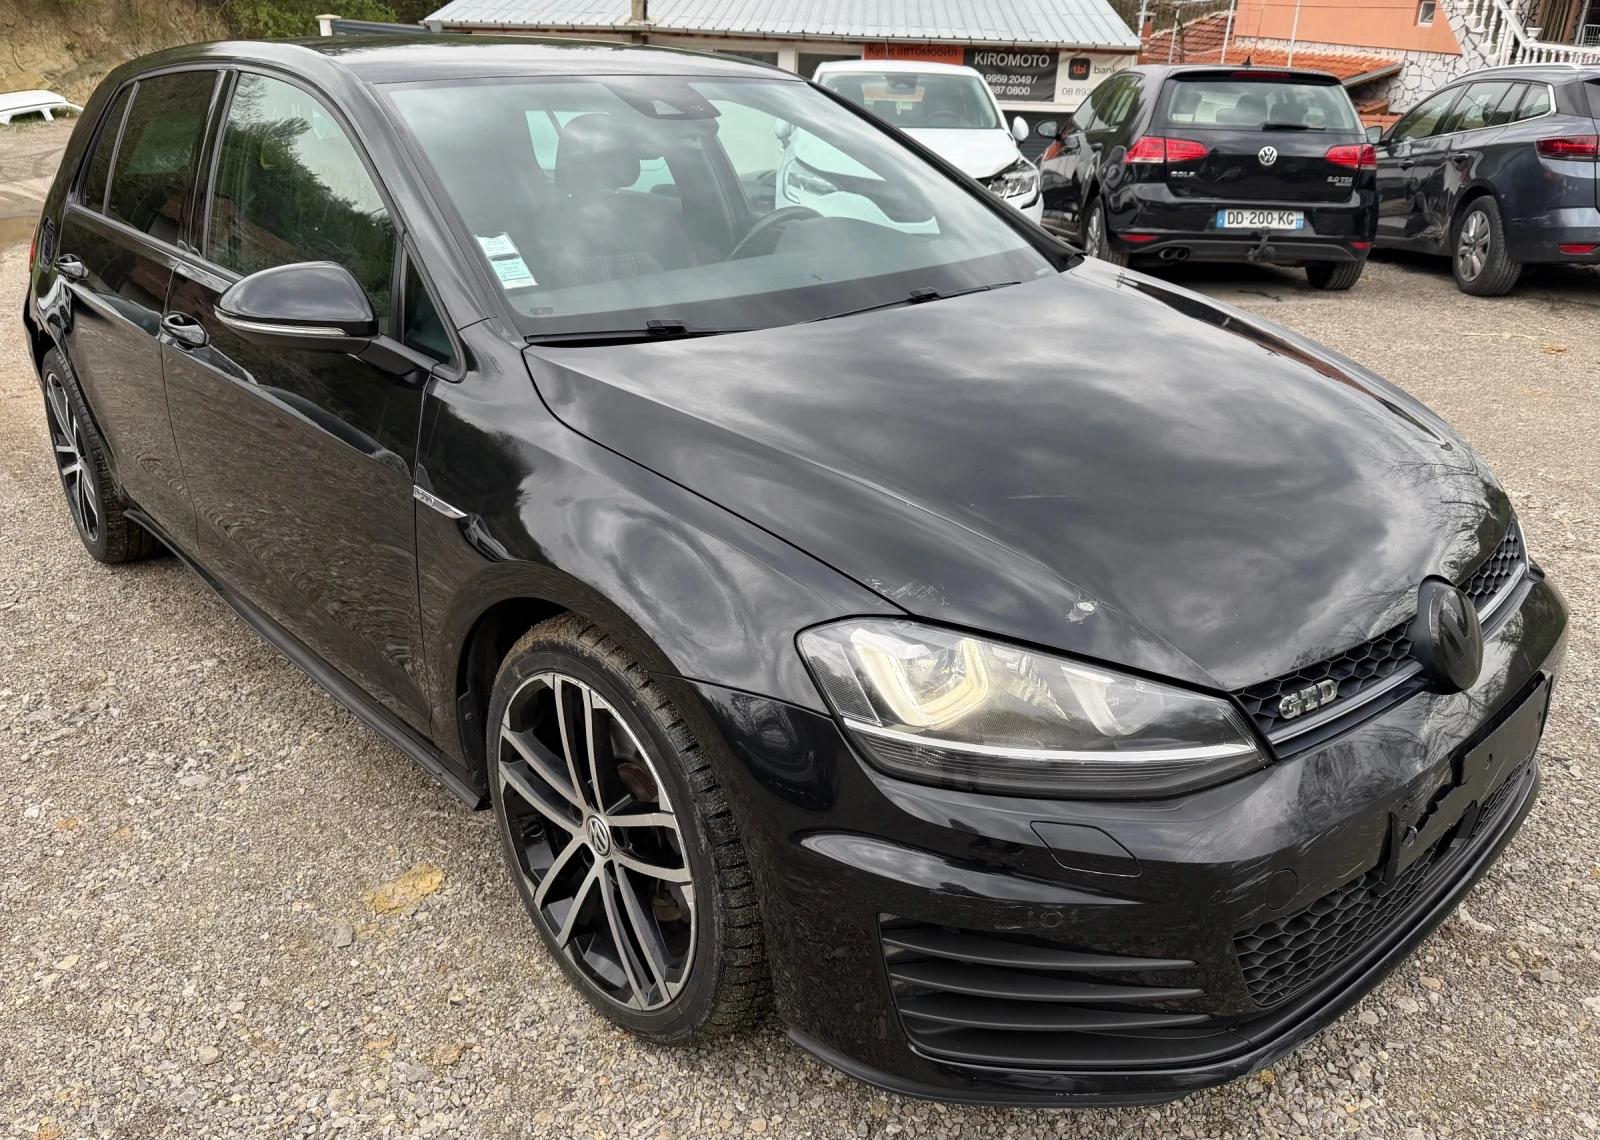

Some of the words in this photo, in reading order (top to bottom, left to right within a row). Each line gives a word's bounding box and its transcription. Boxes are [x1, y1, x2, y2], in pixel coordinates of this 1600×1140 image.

[897, 47, 958, 57] автомобил
[974, 52, 1050, 67] KIROMOTO
[1073, 64, 1087, 74] tbi
[1093, 65, 1118, 75] bank
[985, 74, 1008, 84] 9959
[1008, 75, 1032, 85] 2049
[1006, 86, 1031, 95] 0800
[1170, 170, 1196, 178] GOLF
[1279, 679, 1338, 720] GTD
